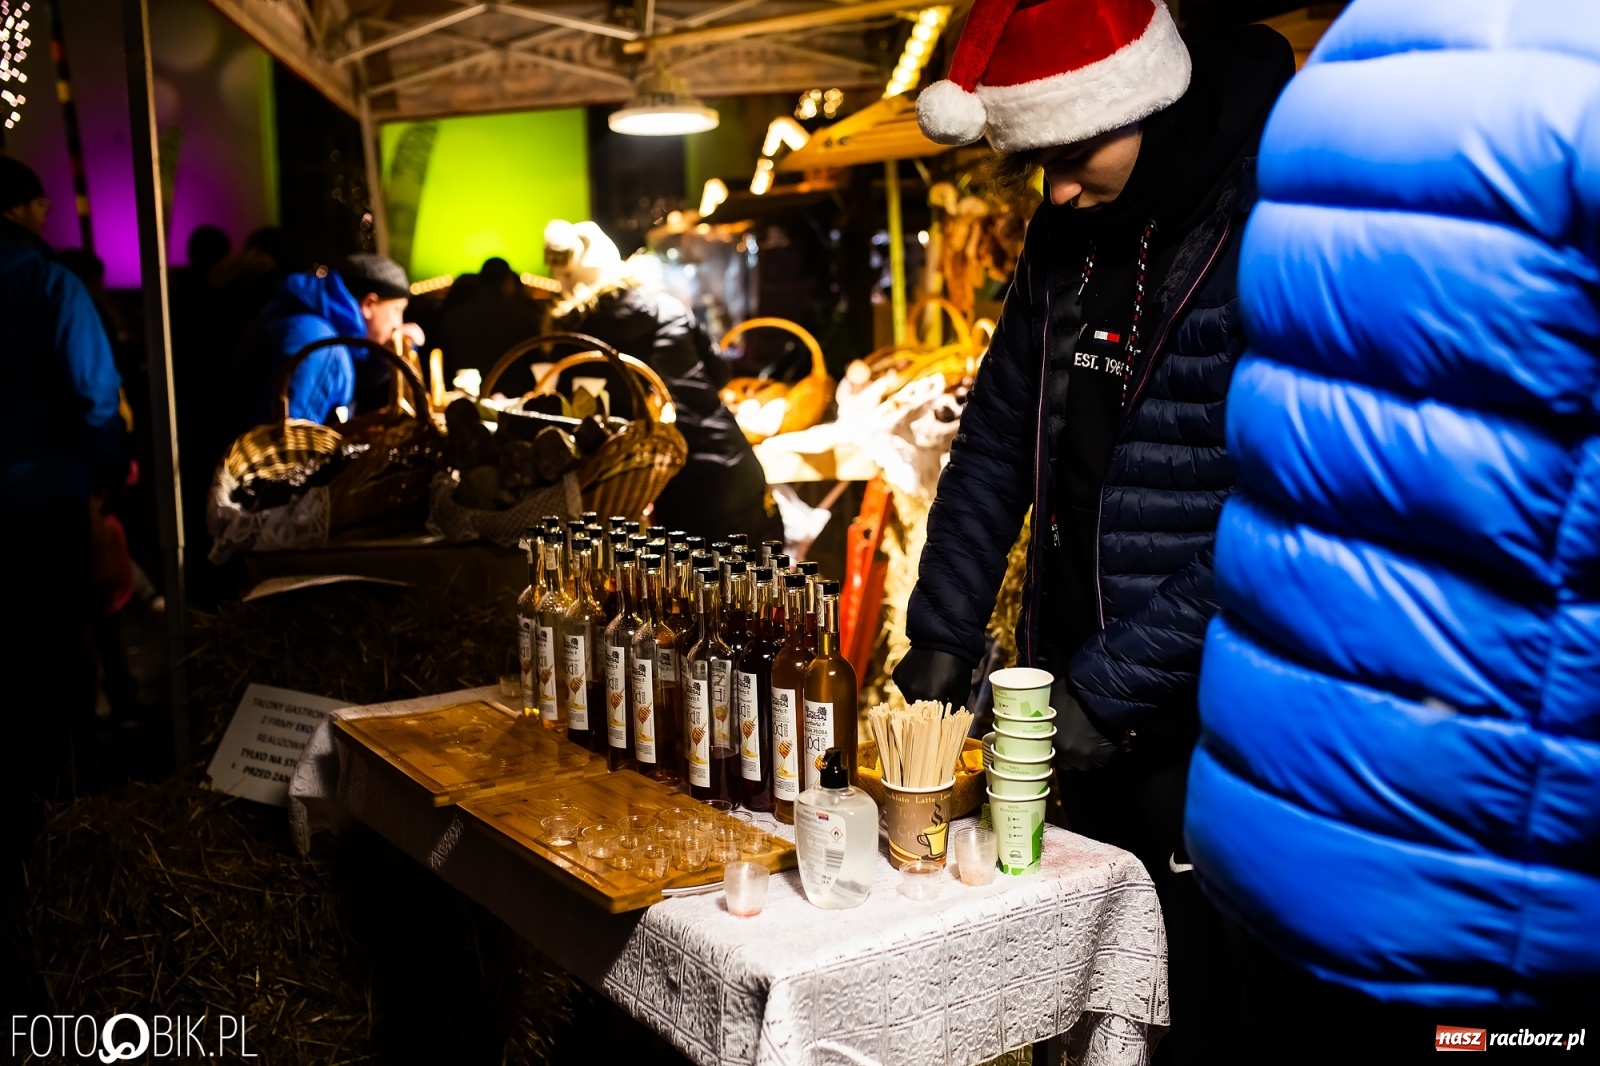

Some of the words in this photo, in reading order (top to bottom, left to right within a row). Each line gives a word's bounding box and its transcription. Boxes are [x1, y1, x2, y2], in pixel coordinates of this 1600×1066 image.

[1073, 352, 1099, 370] EST.
[1105, 356, 1124, 377] 198
[284, 703, 327, 720] GASTRON
[256, 731, 306, 751] REALIZOWA
[241, 747, 268, 762] TYLKO
[915, 795, 936, 804] Latte
[896, 805, 916, 819] Tea
[897, 824, 927, 838] Coff
